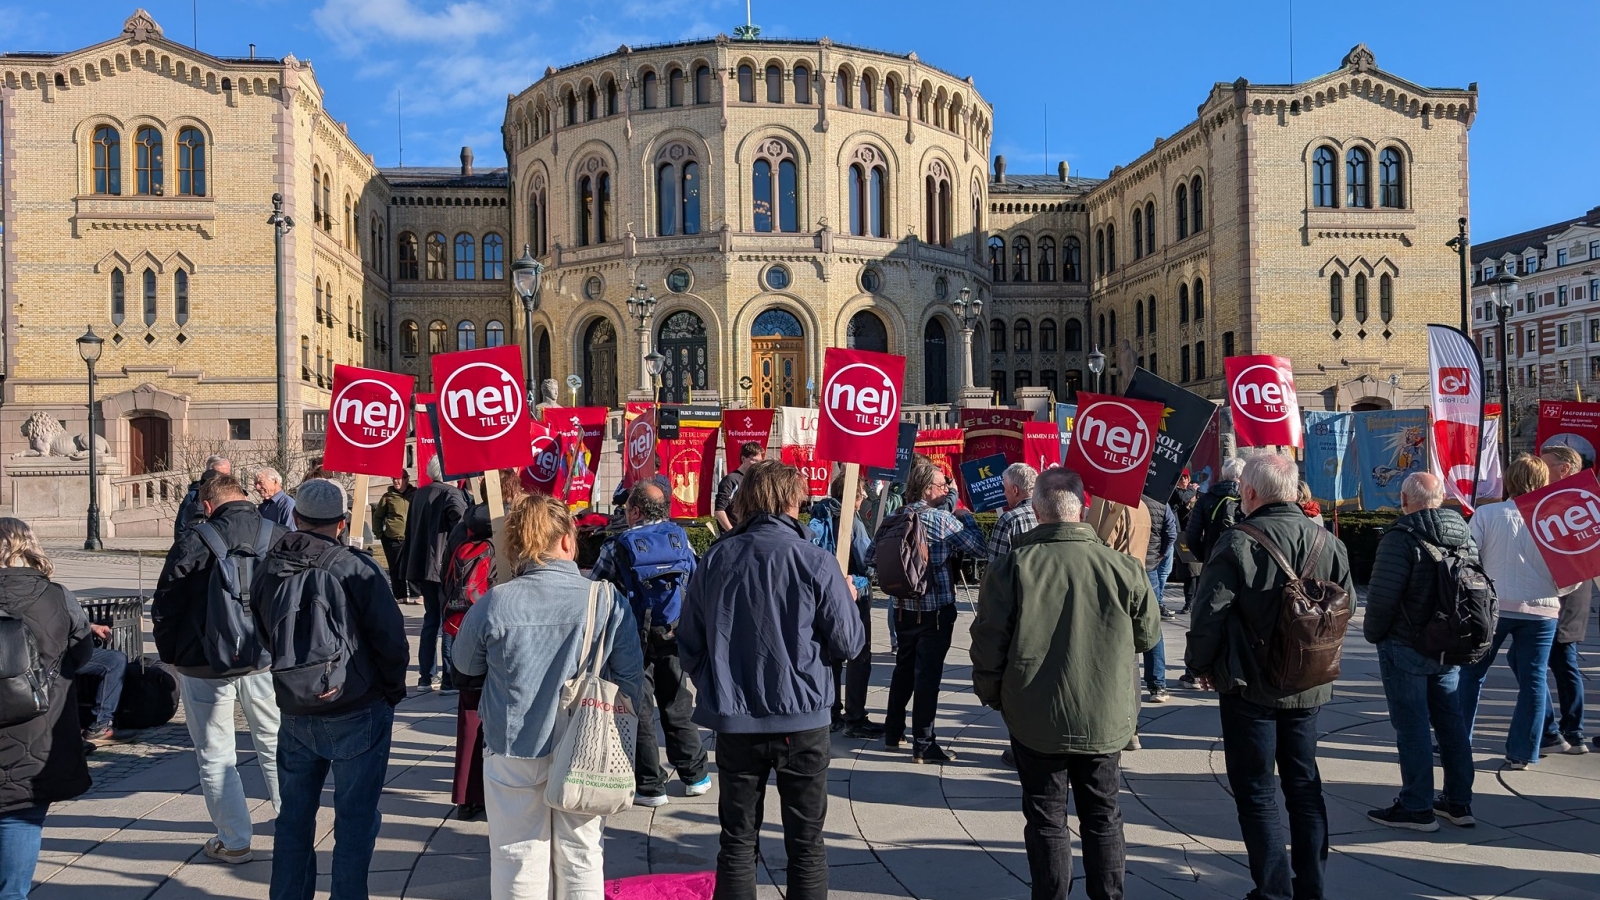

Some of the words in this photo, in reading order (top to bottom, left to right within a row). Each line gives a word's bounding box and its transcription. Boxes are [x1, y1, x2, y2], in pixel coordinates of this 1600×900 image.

[448, 372, 514, 418] nei
[831, 378, 890, 416] nei
[1238, 376, 1291, 405] nei
[339, 392, 398, 428] nei
[479, 417, 497, 427] TIL
[500, 414, 515, 425] EU
[855, 414, 870, 424] TIL
[873, 416, 888, 426] EU
[1264, 405, 1279, 413] TIL
[363, 427, 378, 437] TIL
[381, 429, 395, 439] EU
[630, 426, 650, 459] nei
[1082, 416, 1146, 458] nei
[532, 445, 558, 471] nei
[1104, 450, 1118, 463] TIL
[1121, 456, 1137, 467] EU
[1538, 492, 1600, 542] nei
[1573, 530, 1592, 541] TIL
[1592, 524, 1600, 535] E
